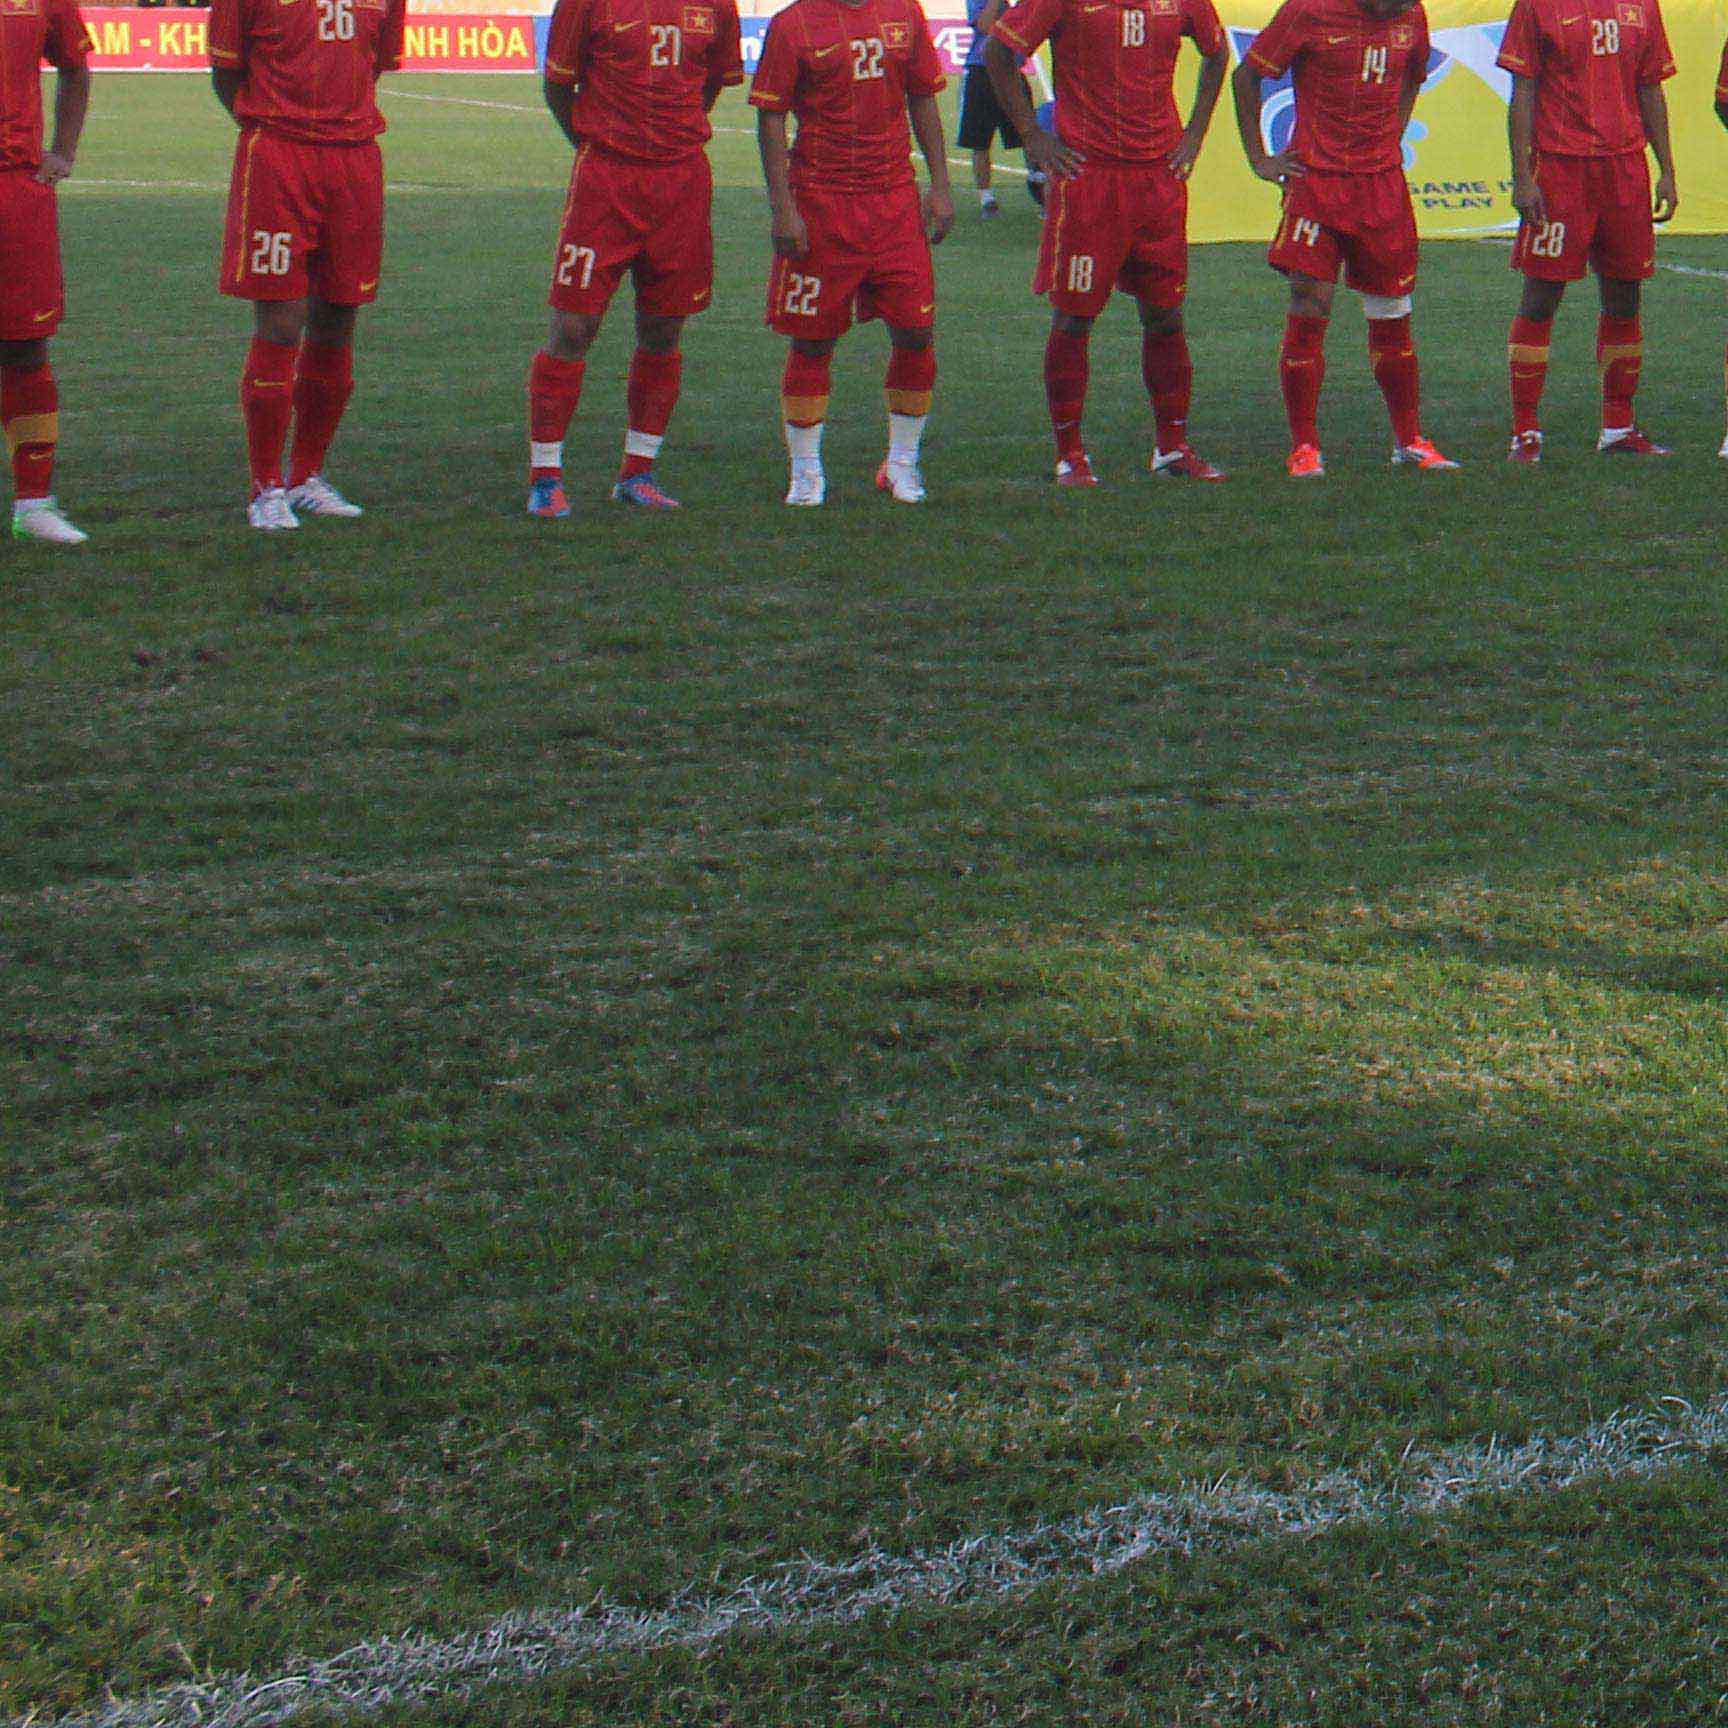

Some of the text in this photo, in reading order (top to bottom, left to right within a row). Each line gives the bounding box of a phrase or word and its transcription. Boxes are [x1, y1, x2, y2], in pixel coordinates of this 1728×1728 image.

[159, 22, 206, 55] KH
[404, 25, 449, 58] NH
[457, 19, 528, 58] HÒA
[650, 24, 682, 66] 27
[1122, 9, 1145, 47] 18
[1591, 19, 1620, 56] 28
[852, 36, 884, 79] 22
[1362, 46, 1385, 83] 14
[1424, 197, 1493, 209] PLAY
[1292, 218, 1319, 247] 14
[1532, 222, 1564, 257] 28
[251, 232, 291, 275] 26
[559, 245, 595, 289] 27
[1067, 256, 1092, 292] 18
[785, 274, 821, 316] 22
